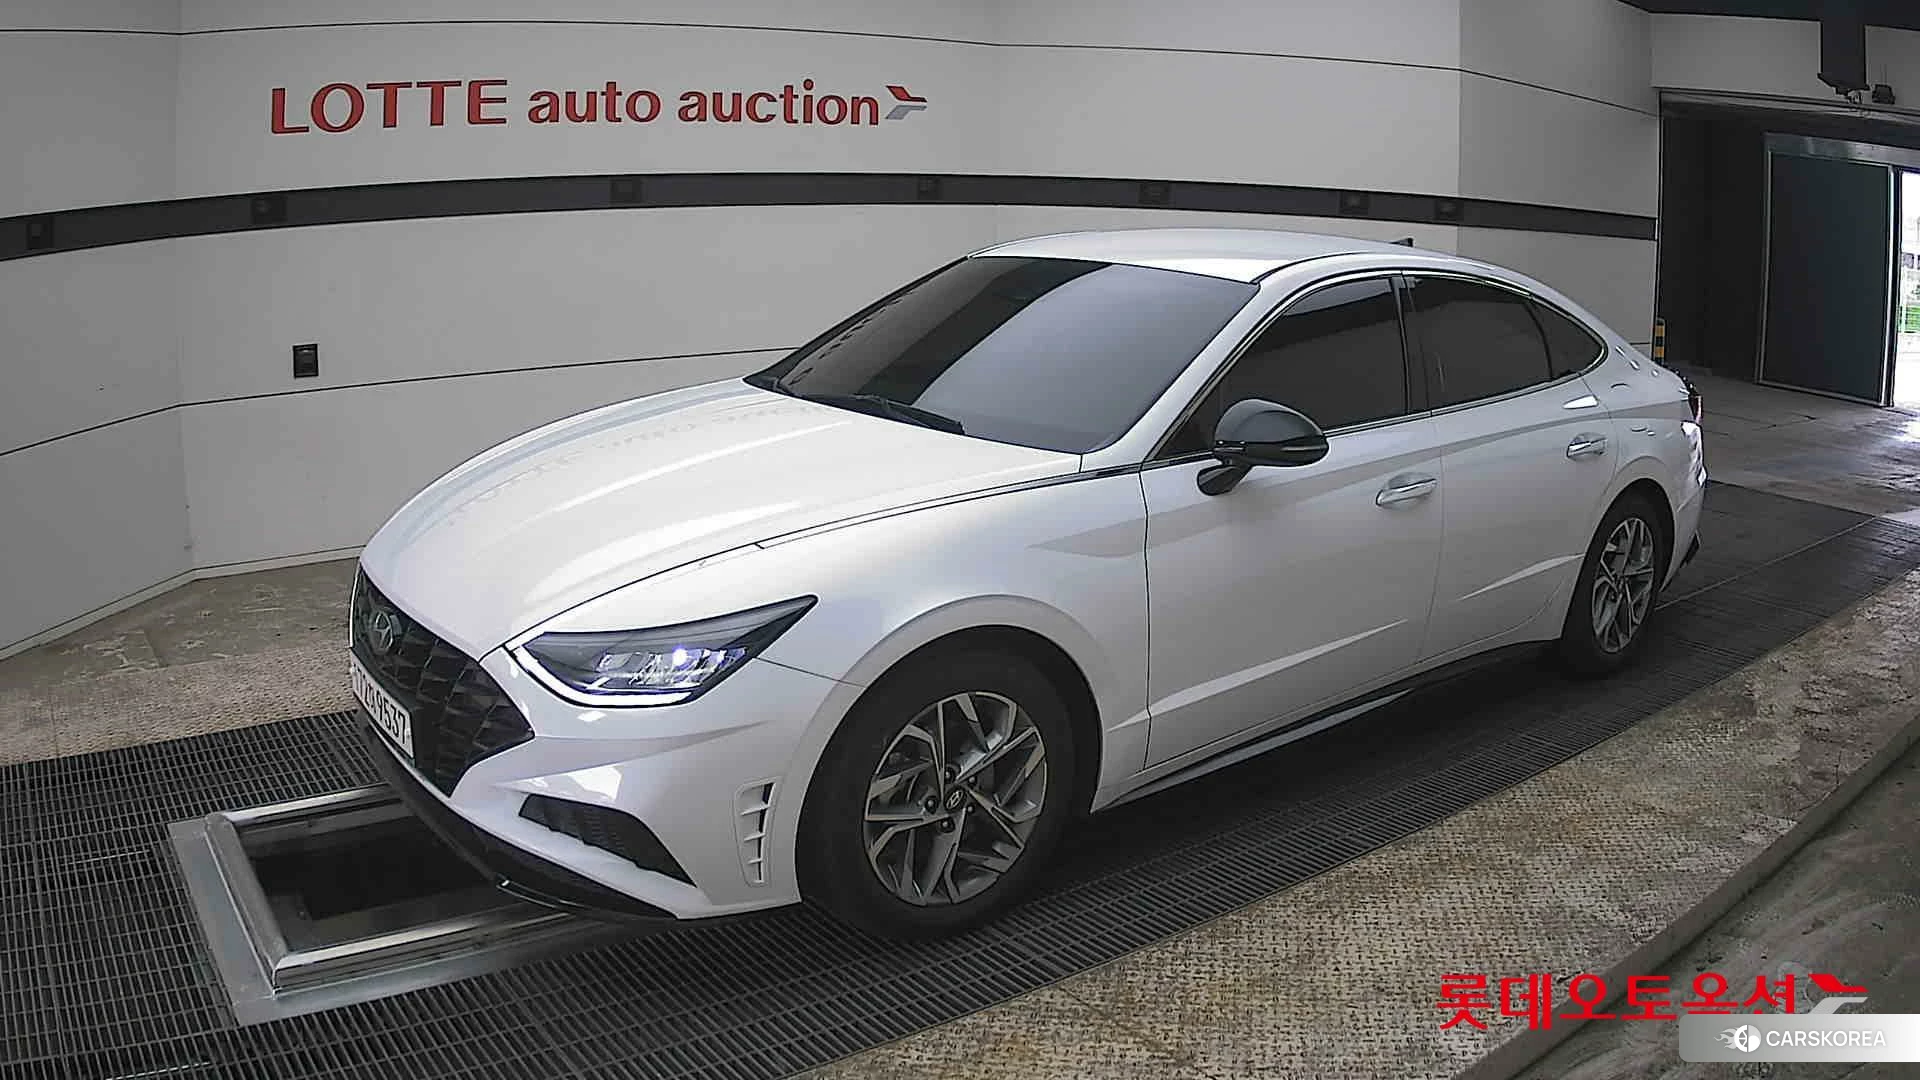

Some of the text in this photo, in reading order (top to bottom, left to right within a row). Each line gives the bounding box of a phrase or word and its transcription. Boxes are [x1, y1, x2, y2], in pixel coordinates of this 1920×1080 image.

[270, 79, 880, 135] LOTTE auto auction
[376, 689, 407, 745] 9537
